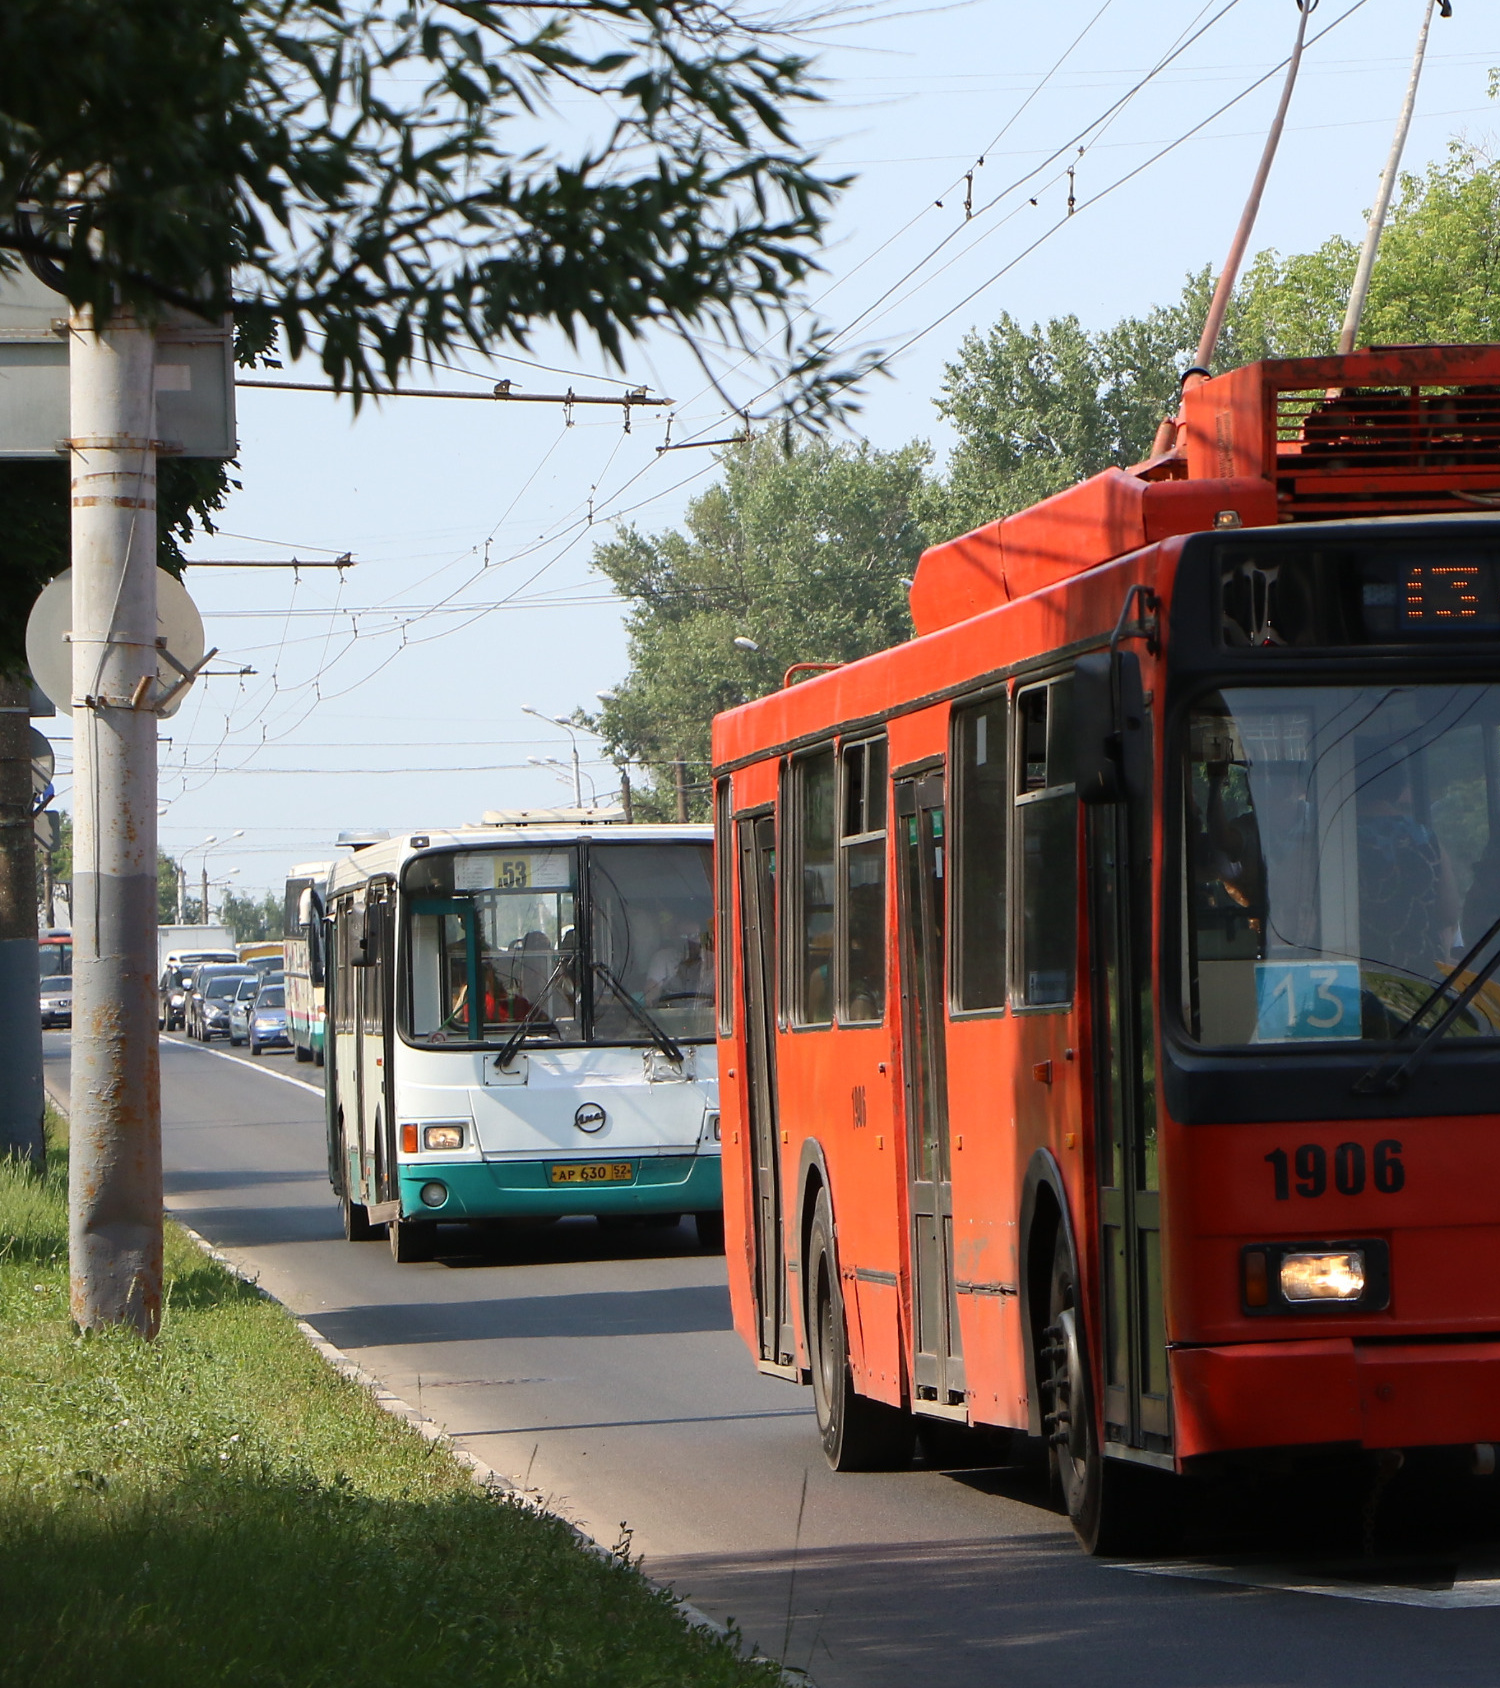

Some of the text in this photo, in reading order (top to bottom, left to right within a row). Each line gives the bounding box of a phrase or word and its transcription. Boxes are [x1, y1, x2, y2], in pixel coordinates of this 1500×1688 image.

[502, 860, 527, 888] 53
[1272, 969, 1343, 1029] 13
[558, 1165, 627, 1181] АР 630 52
[1263, 1138, 1405, 1201] 1906
